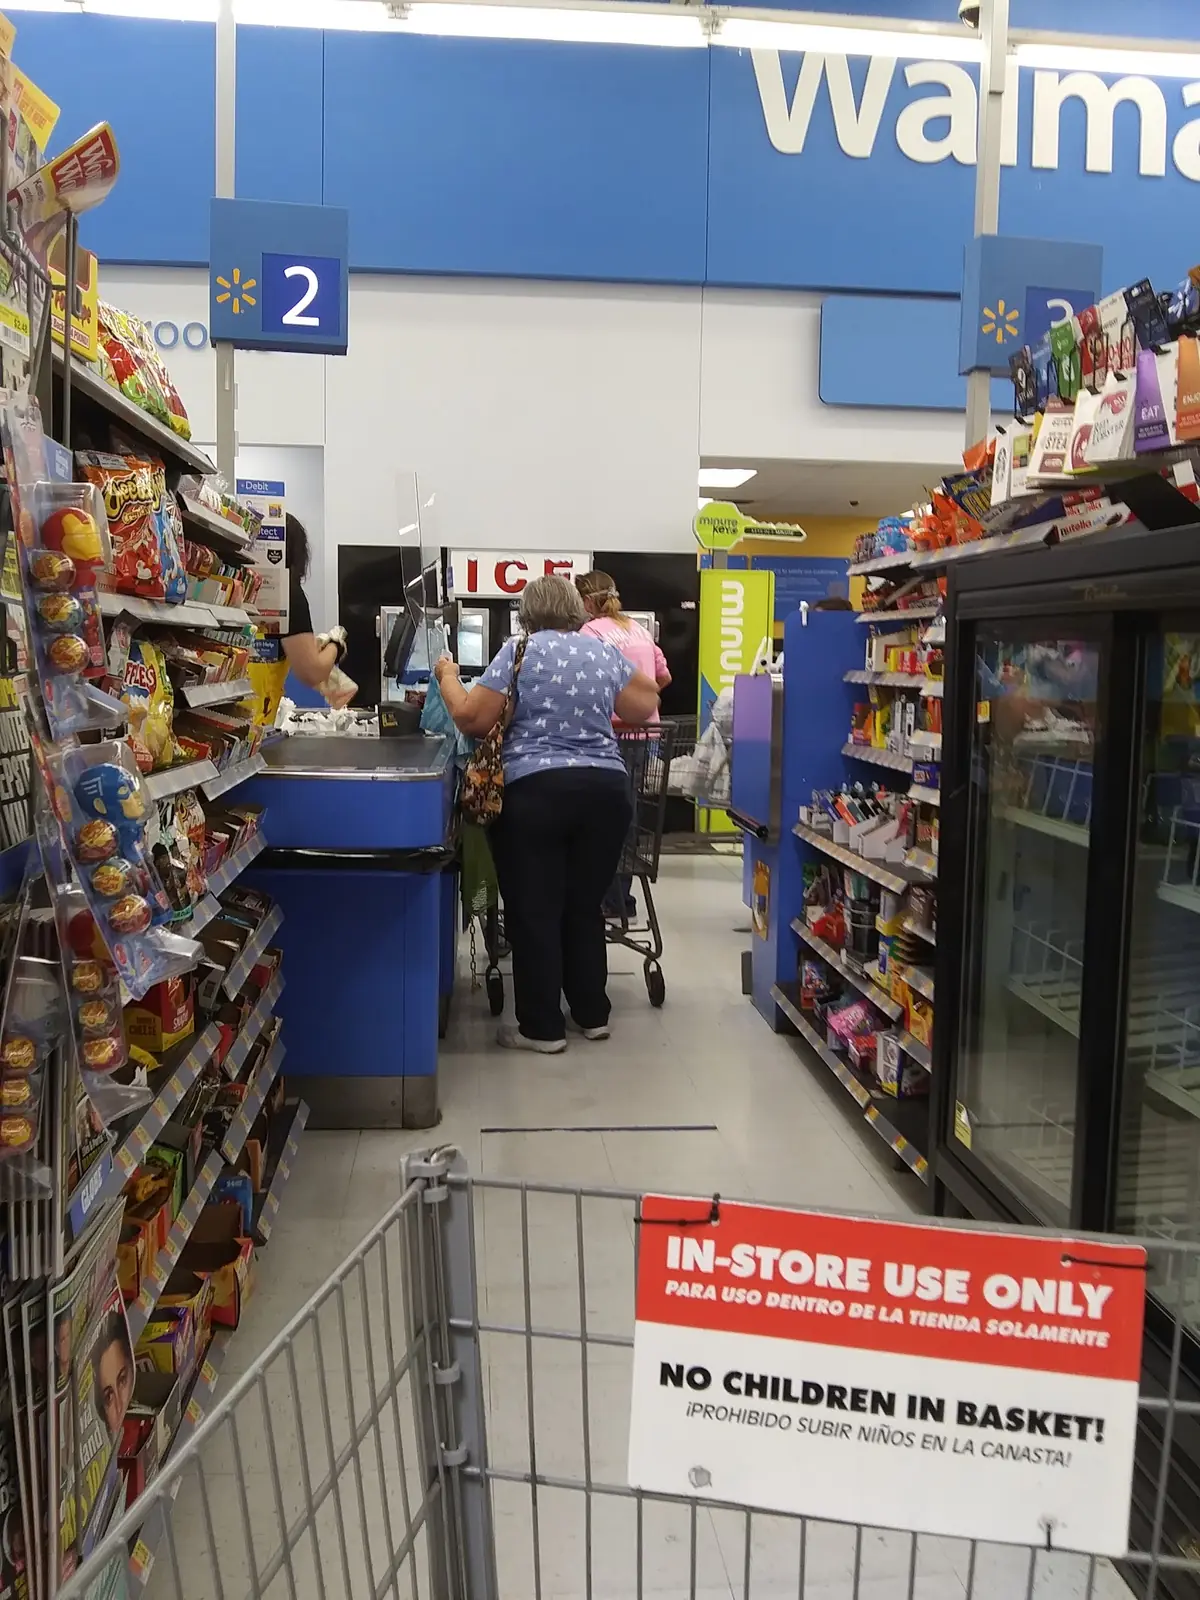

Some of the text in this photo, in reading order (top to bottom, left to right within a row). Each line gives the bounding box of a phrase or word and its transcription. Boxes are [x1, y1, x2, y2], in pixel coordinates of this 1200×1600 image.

[281, 265, 320, 327] 2
[144, 320, 208, 350] oo
[245, 481, 269, 493] Debit
[699, 516, 738, 527] minute
[1060, 519, 1092, 538] nutella
[666, 1235, 1114, 1320] IN-STORE USE ONLY
[665, 1280, 1111, 1348] PARA USO DENTRO DE LA TIENDA SOLAMENTE
[659, 1361, 1105, 1443] NO CHILDREN IN BASKET!
[797, 1416, 853, 1440] SUBIR
[857, 1424, 915, 1448] NIÑOS
[920, 1433, 947, 1452] EN
[952, 1437, 975, 1456] LA
[981, 1440, 1072, 1468] CANASTA!
